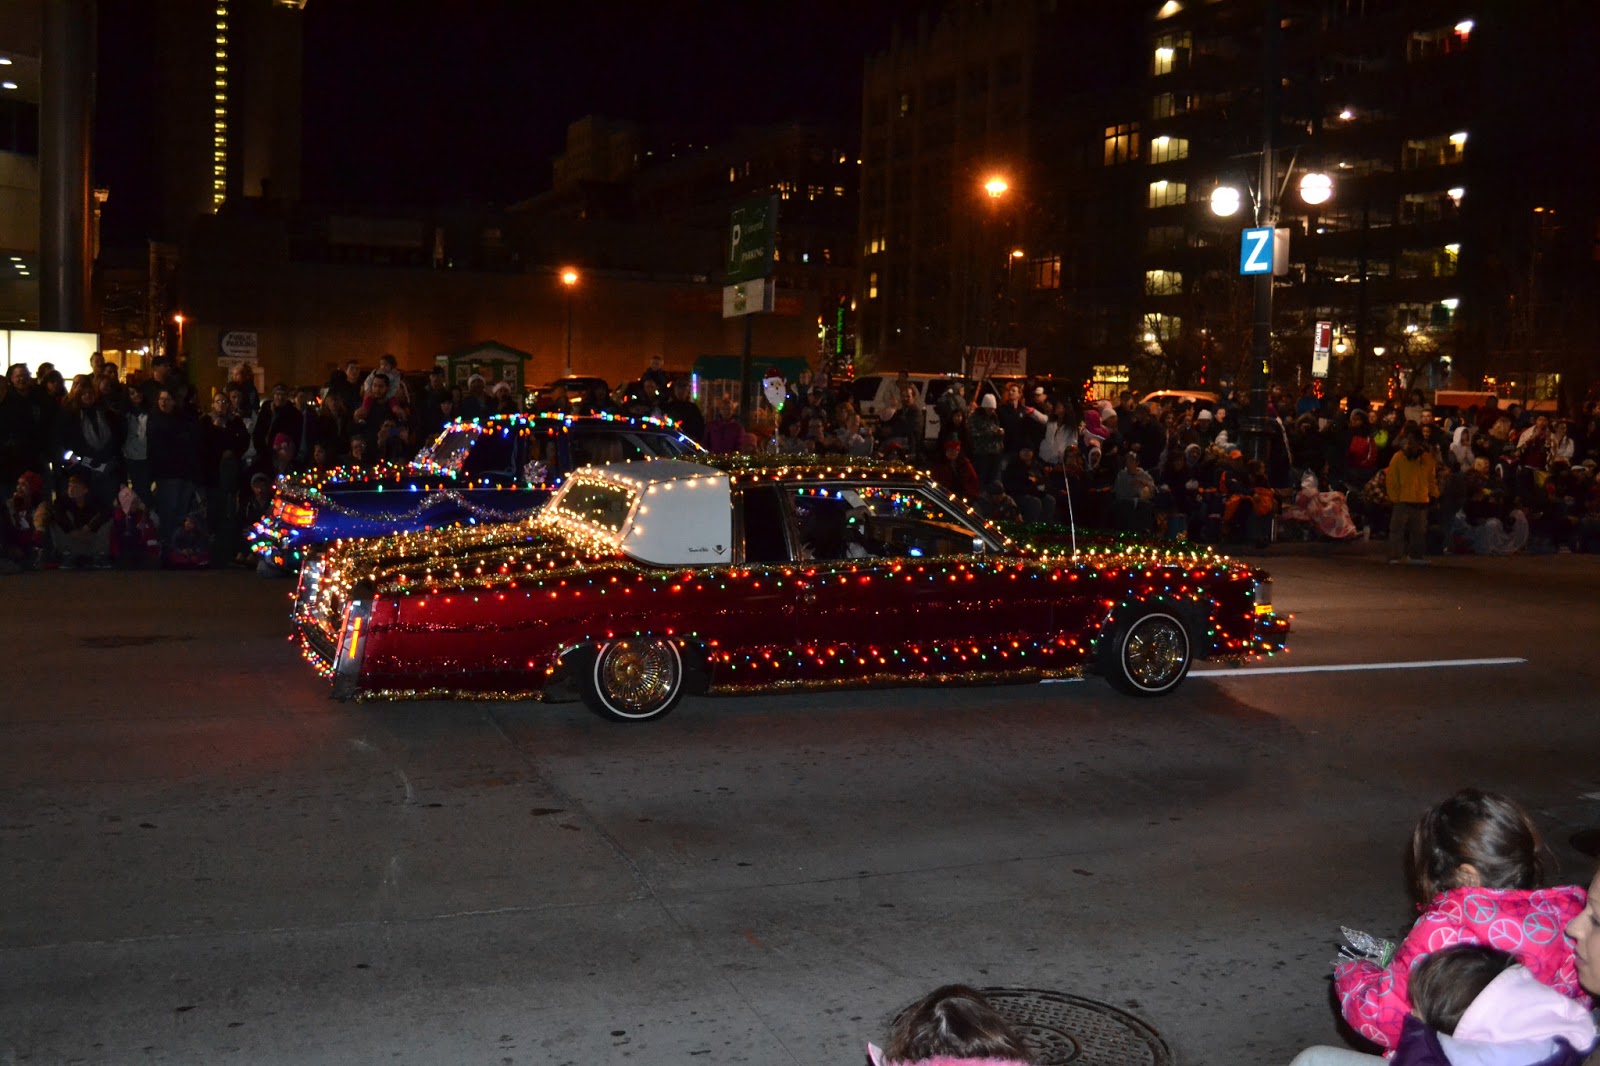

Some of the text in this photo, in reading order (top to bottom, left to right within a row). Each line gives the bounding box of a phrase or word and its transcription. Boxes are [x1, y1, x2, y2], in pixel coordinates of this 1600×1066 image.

[731, 223, 741, 262] P
[741, 246, 764, 262] PARKING
[1244, 230, 1269, 271] Z
